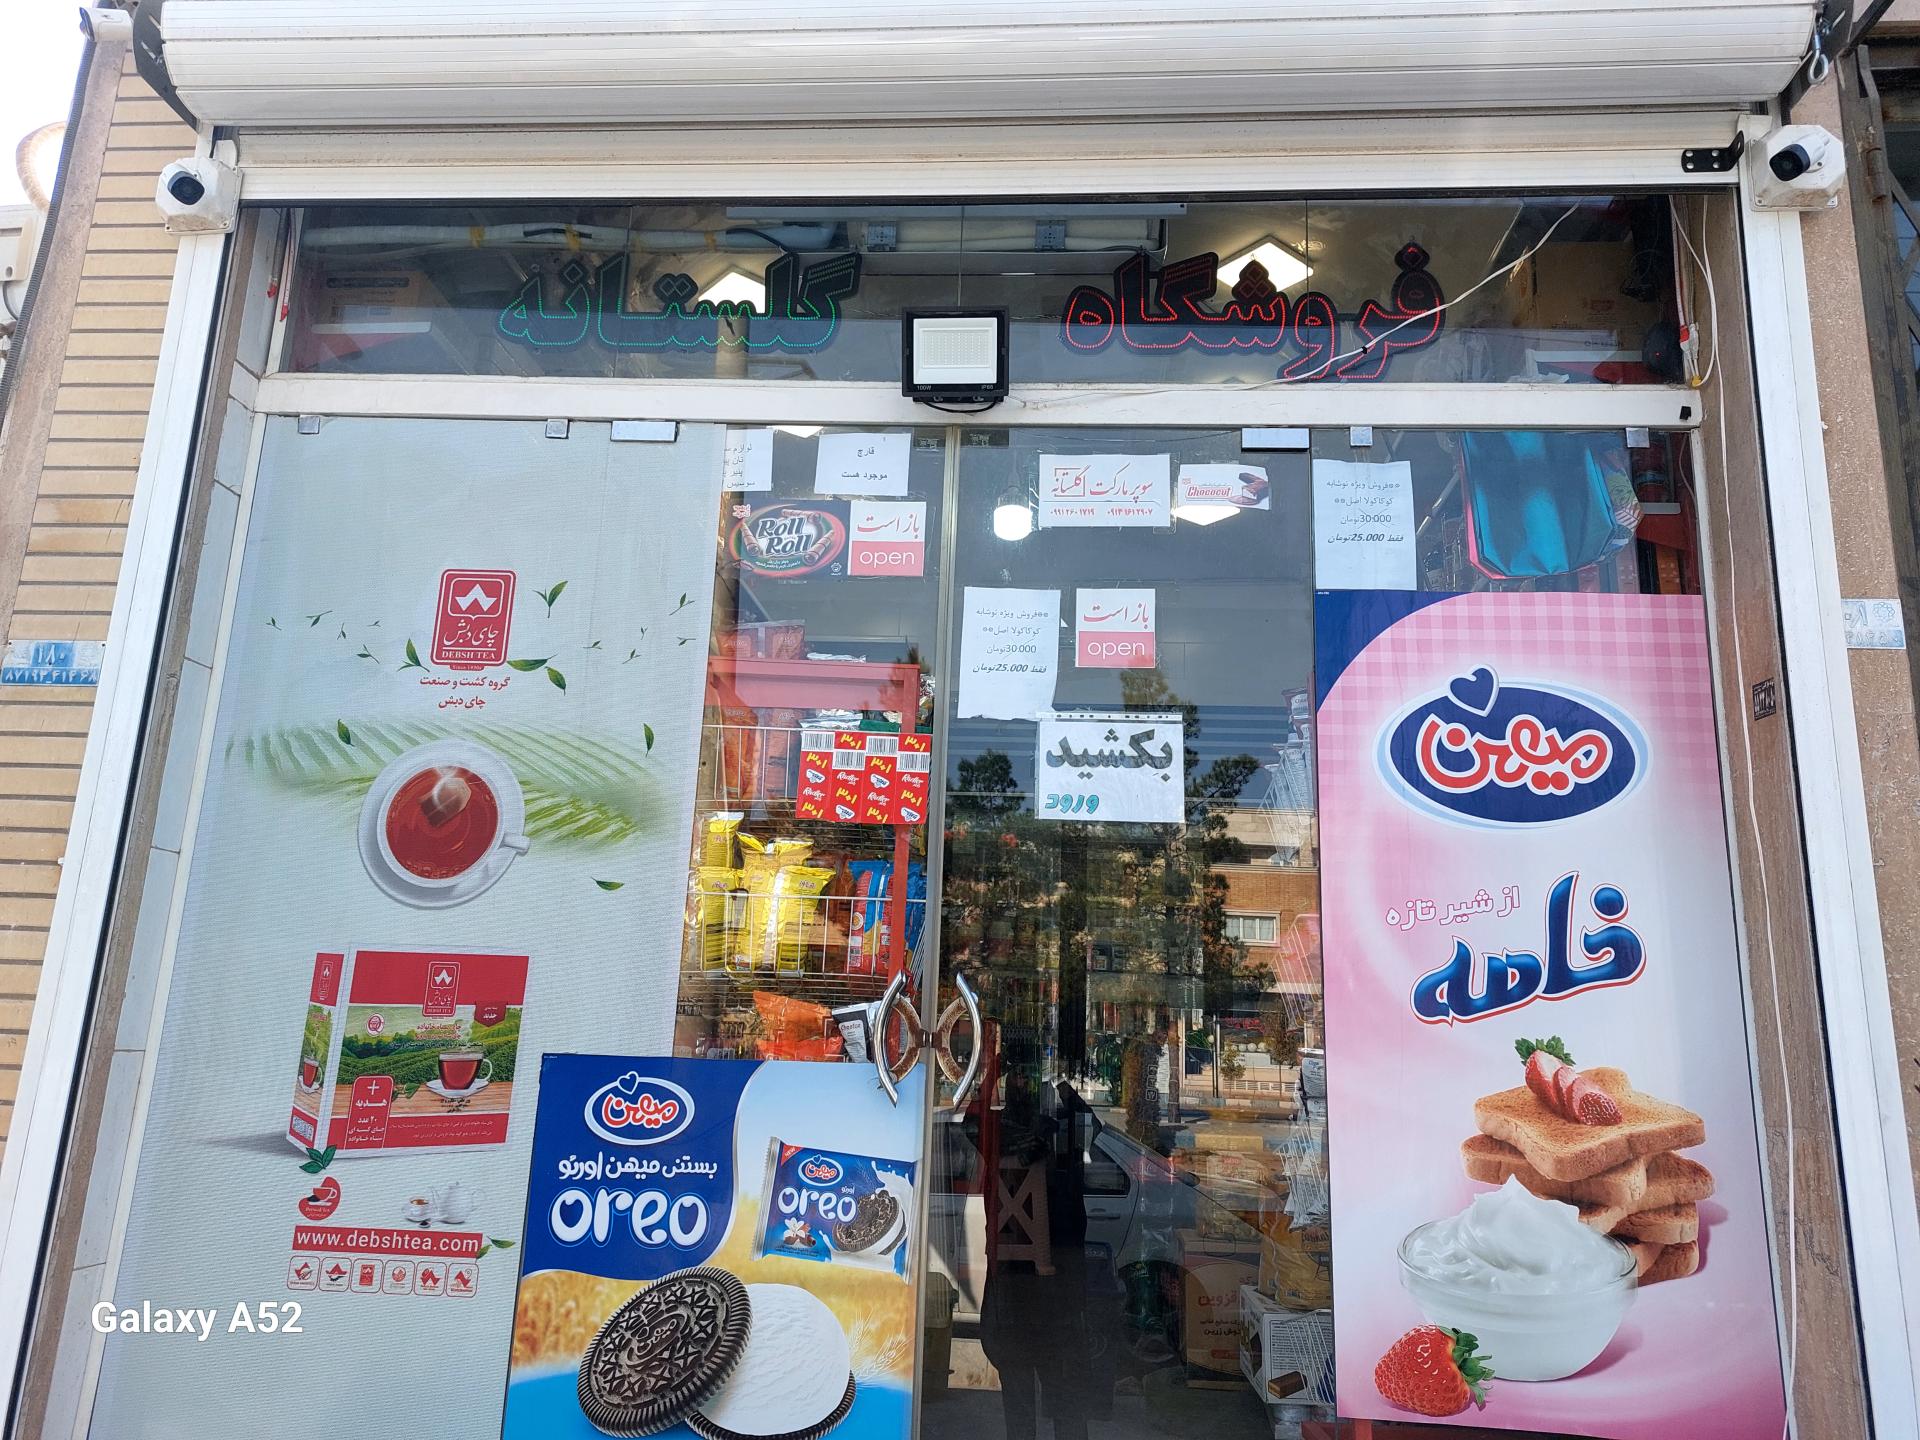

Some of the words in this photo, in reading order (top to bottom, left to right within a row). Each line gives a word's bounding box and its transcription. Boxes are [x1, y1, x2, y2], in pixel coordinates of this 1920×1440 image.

[498, 252, 860, 350] گلستانه
[1065, 242, 1445, 381] فروشگاه
[857, 446, 875, 458] قارچ
[841, 470, 860, 479] هست
[863, 470, 888, 480] موجود
[1089, 462, 1131, 495] مارکت
[757, 517, 805, 538] Roll
[857, 514, 900, 533] است
[902, 513, 920, 539] باز
[765, 534, 811, 555] Roll
[859, 550, 915, 568] open
[1083, 604, 1128, 623] است
[1131, 602, 1149, 630] باز
[443, 618, 472, 646] دبش
[471, 623, 500, 647] چای
[442, 651, 476, 659] DEBSH
[477, 651, 496, 660] TEA
[1087, 640, 1145, 660] open
[419, 676, 451, 686] صنعت
[452, 680, 458, 690] و
[459, 676, 487, 687] کشت
[488, 676, 511, 691] گروه
[438, 695, 463, 708] دبش
[465, 696, 486, 709] چای
[1045, 728, 1173, 782] بکشید
[1415, 714, 1613, 795] میهن
[1045, 793, 1100, 815] ورود
[1439, 888, 1494, 925] شیر
[1497, 885, 1521, 918] از
[1385, 898, 1437, 932] تازه
[1409, 870, 1647, 1028] خامه
[600, 1091, 680, 1129] میهن
[784, 1146, 796, 1157] NEW
[605, 1156, 660, 1178] میهن
[664, 1156, 718, 1181] بستنی
[804, 1162, 837, 1180] میهن
[551, 1187, 707, 1244] oreo
[778, 1187, 857, 1222] oreo
[296, 1229, 479, 1253] www.debshtea.com
